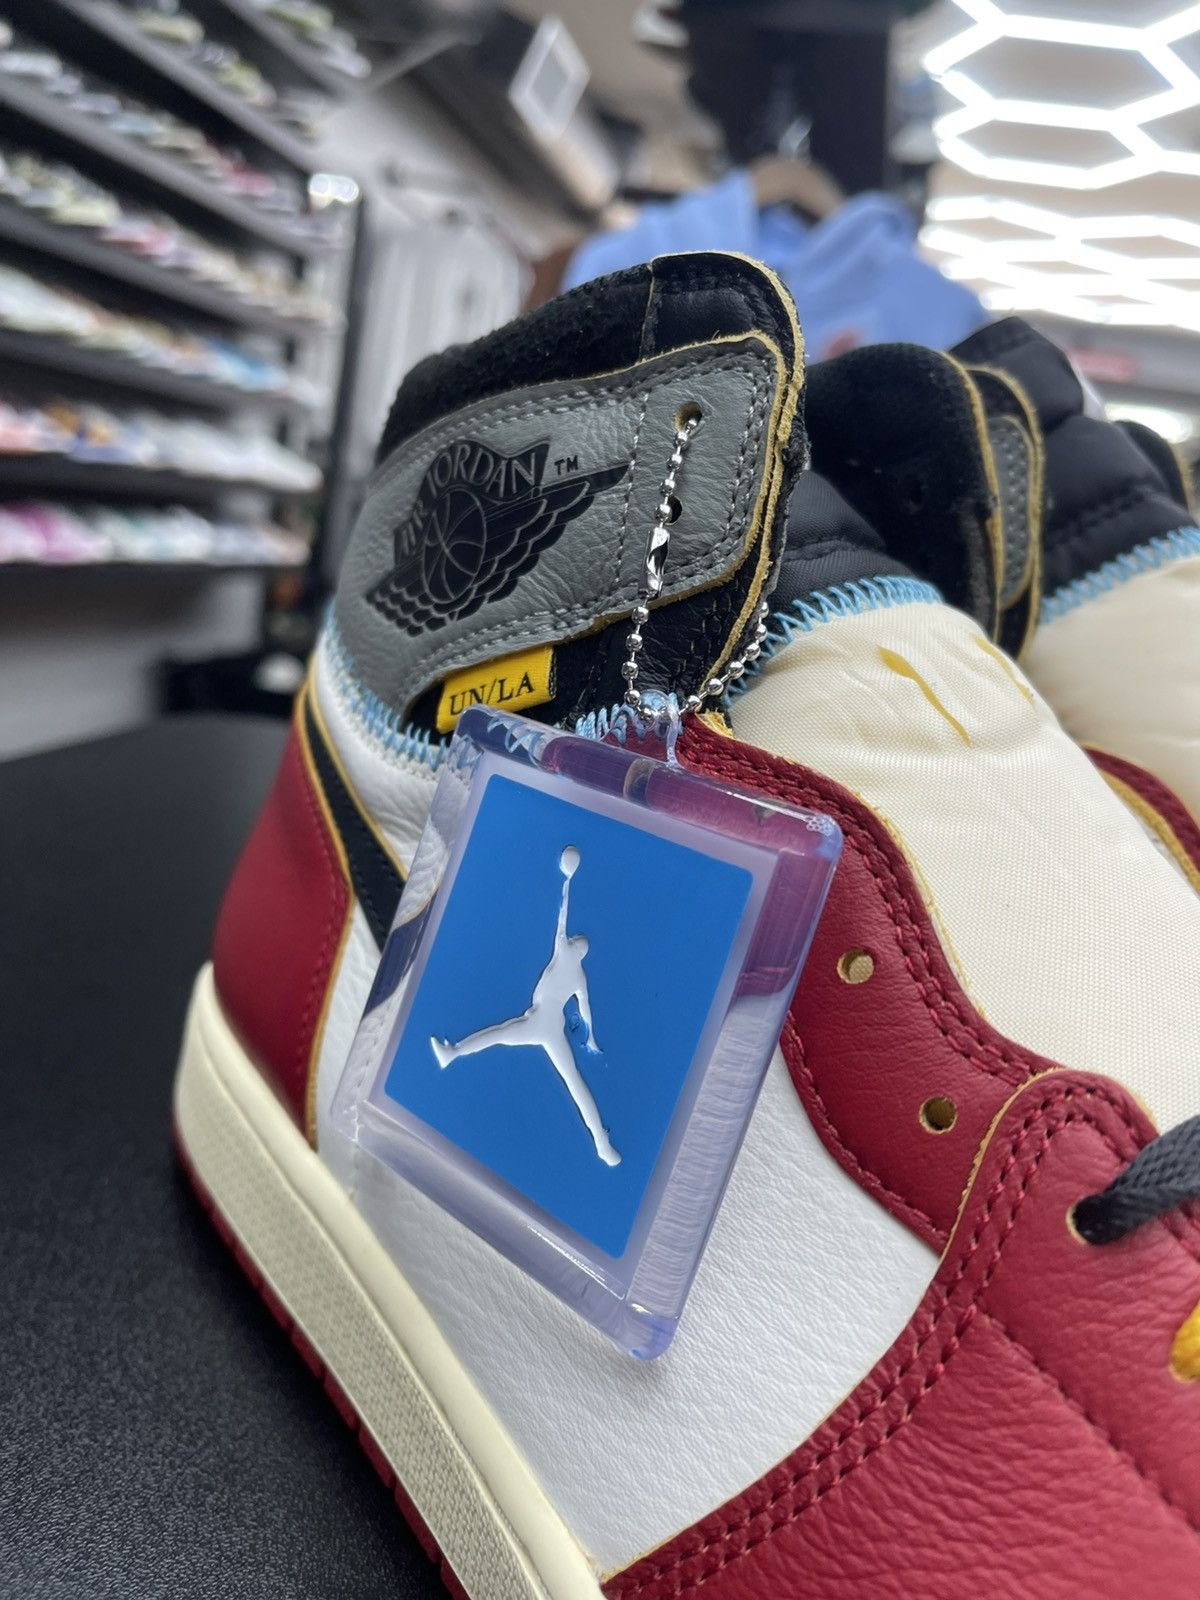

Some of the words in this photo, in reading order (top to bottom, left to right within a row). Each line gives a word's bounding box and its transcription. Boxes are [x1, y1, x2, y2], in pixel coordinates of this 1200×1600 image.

[427, 443, 536, 498] JORDAN
[554, 455, 579, 476] TM
[449, 671, 535, 715] UN/LA
